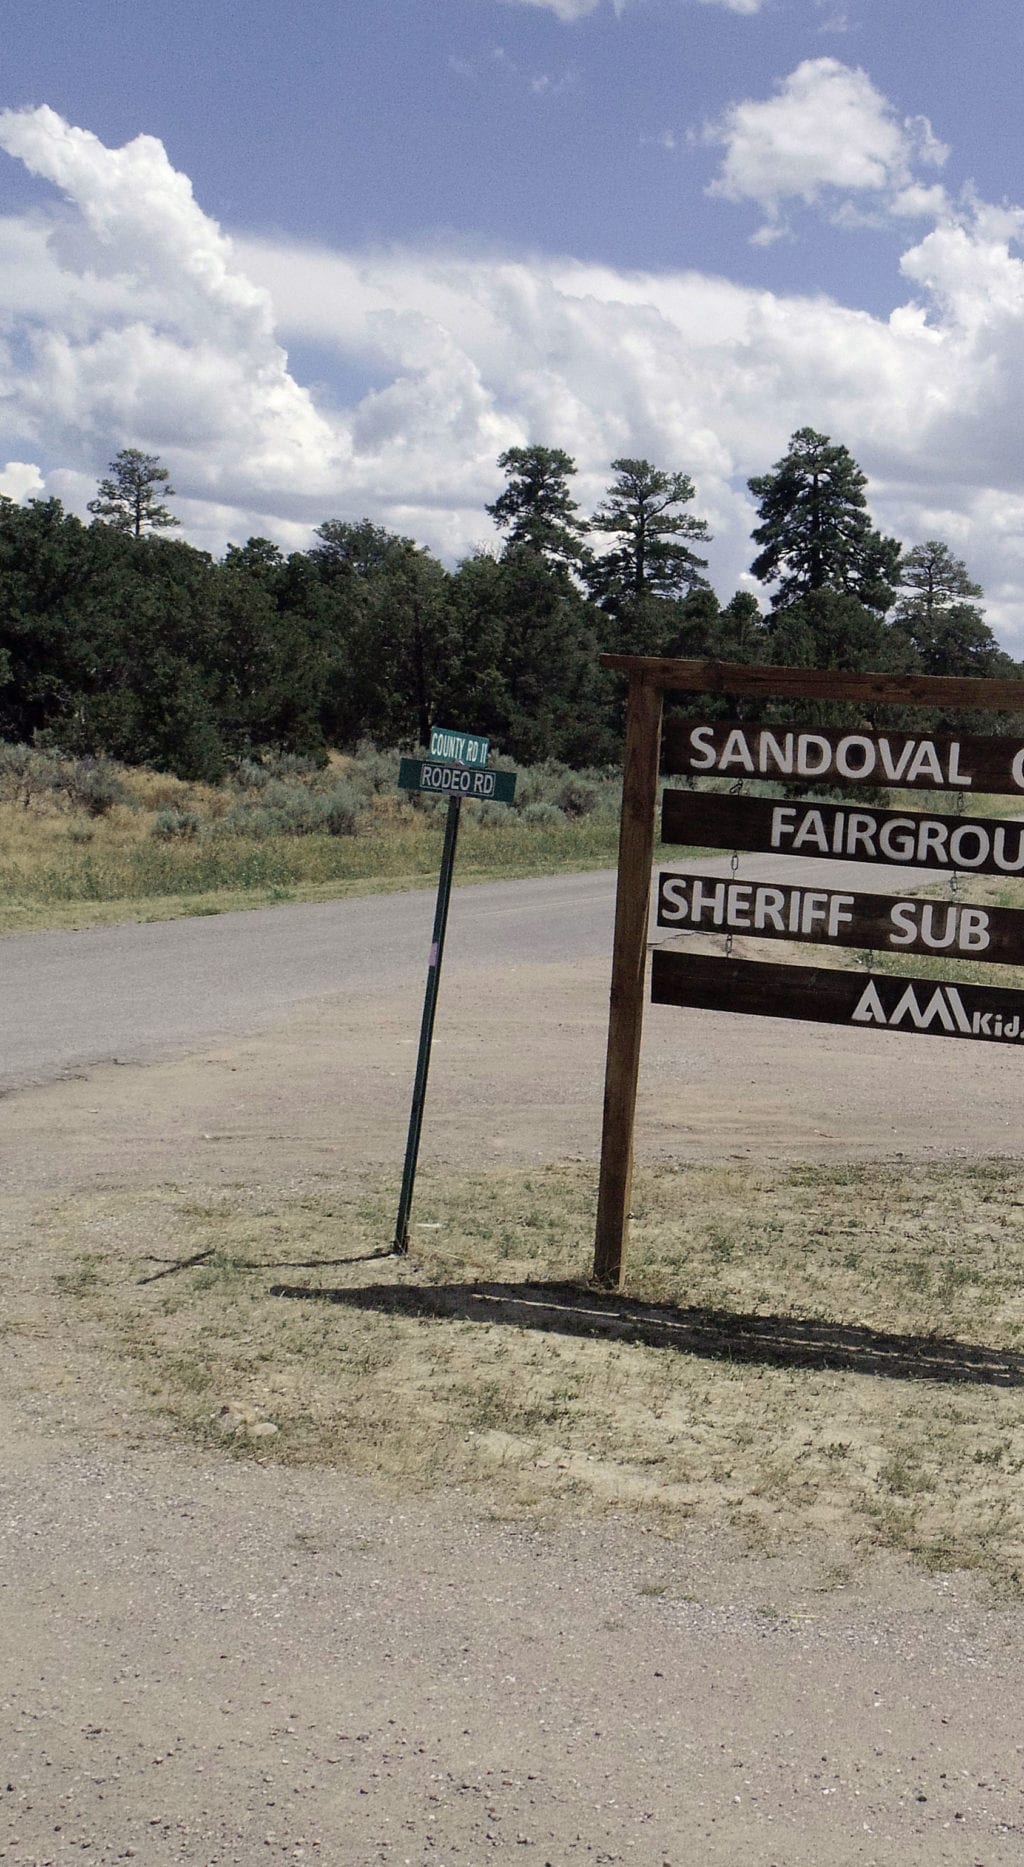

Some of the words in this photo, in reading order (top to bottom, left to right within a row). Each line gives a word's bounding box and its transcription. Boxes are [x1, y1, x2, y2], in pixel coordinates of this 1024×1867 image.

[431, 733, 466, 759] COUNTY
[466, 740, 478, 762] RD
[480, 743, 488, 764] 11
[689, 726, 972, 786] SANDOVAL
[422, 766, 470, 791] RODEO
[473, 773, 493, 794] RD
[661, 878, 855, 937] SHERIFF
[890, 902, 990, 951] SUB
